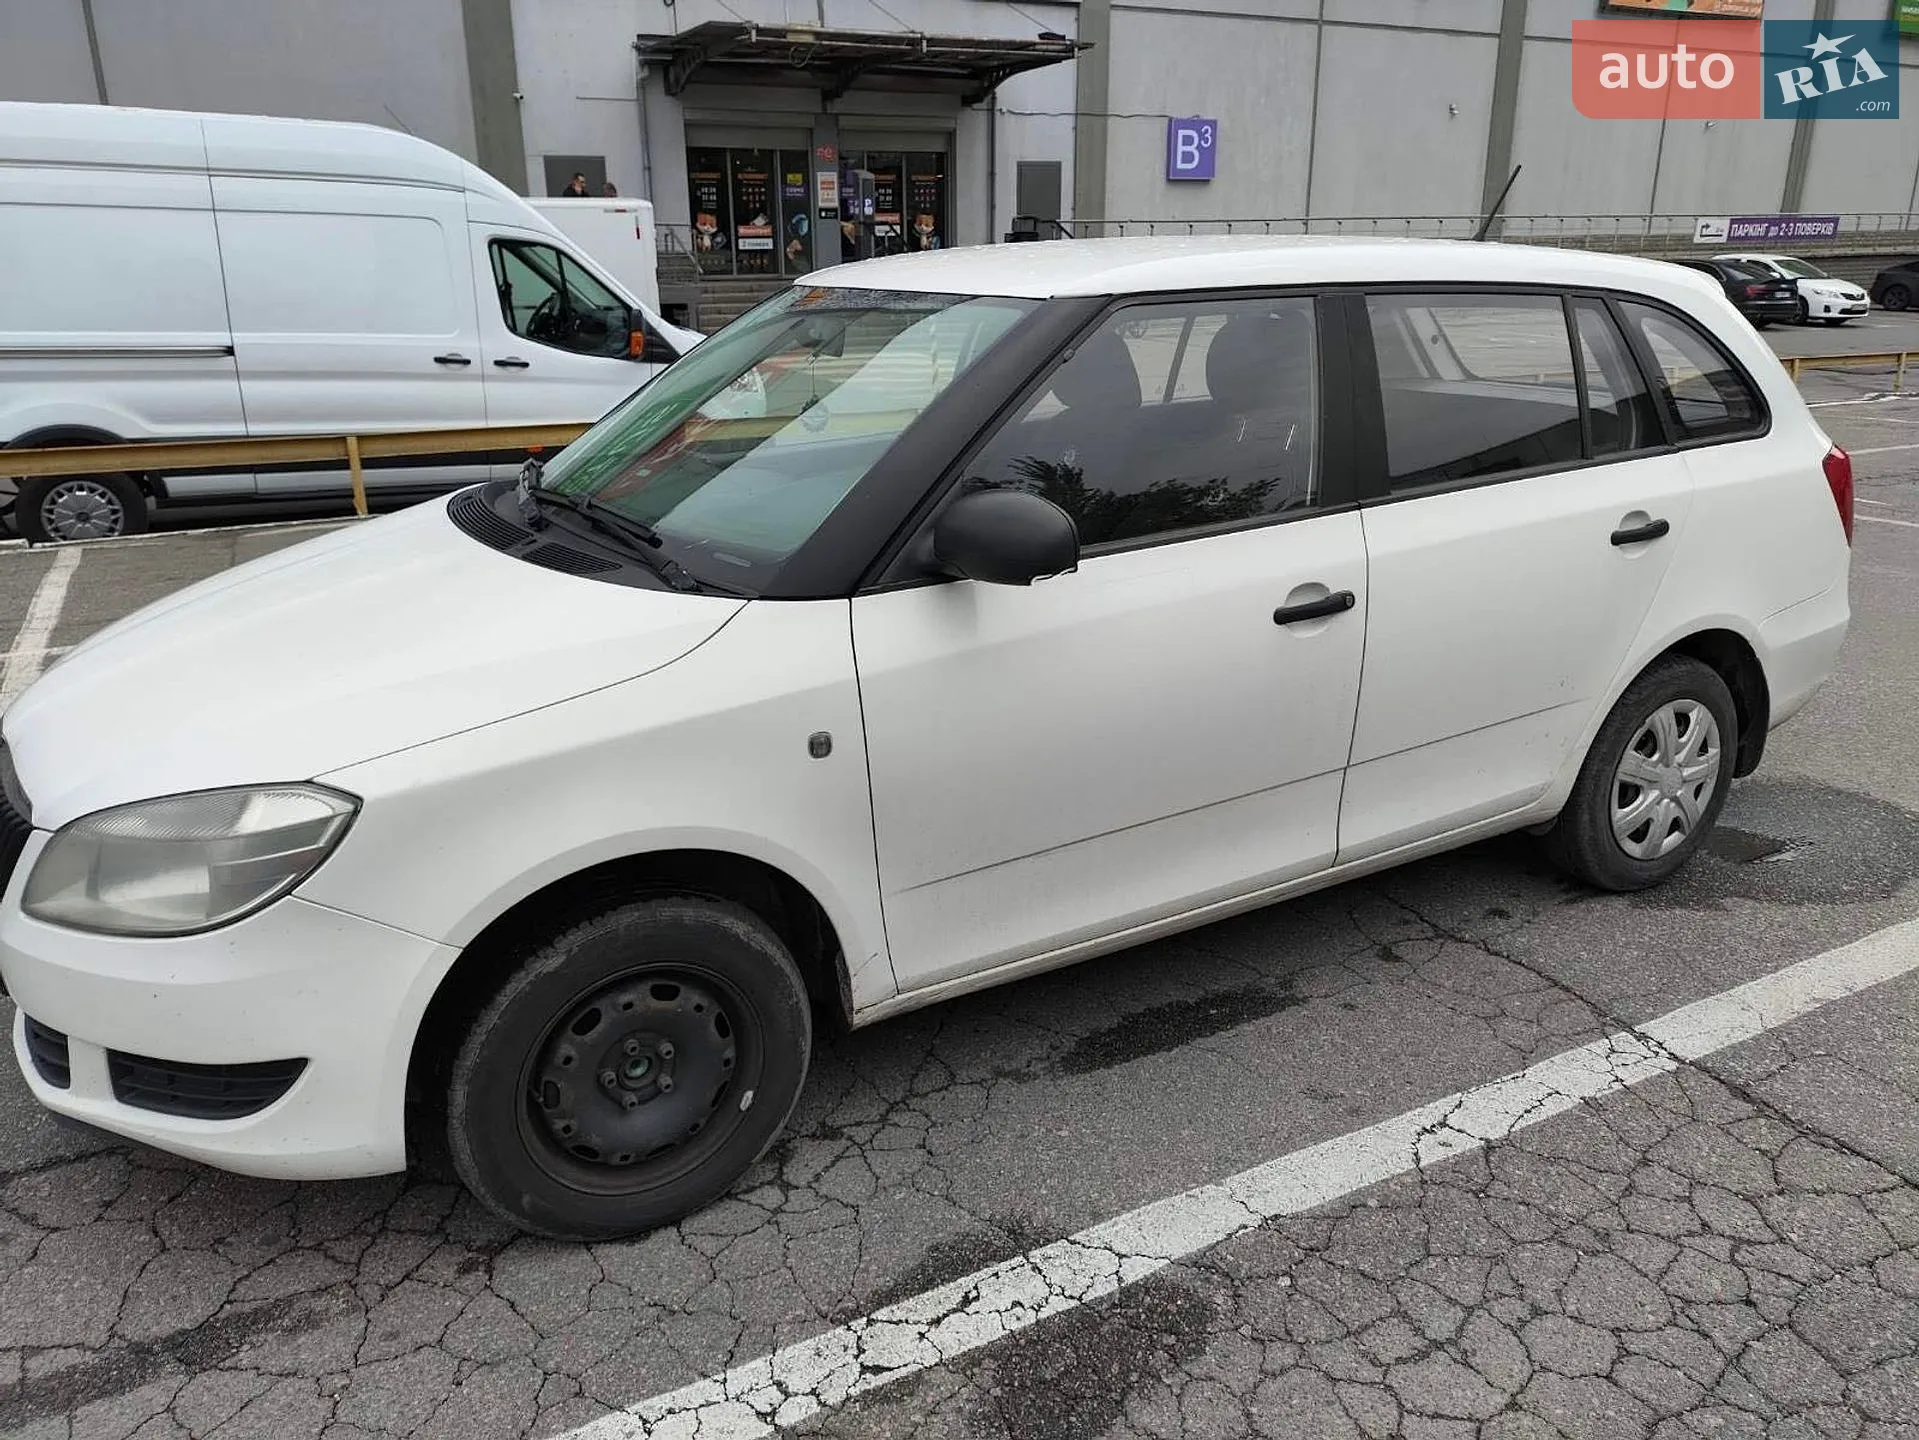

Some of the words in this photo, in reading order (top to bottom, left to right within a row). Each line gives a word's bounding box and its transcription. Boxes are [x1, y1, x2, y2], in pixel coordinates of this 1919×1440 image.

[1730, 223, 1768, 237] ПАРКІНГ
[1780, 223, 1794, 236] 2-3
[1795, 222, 1834, 235] ПОВЕРХІВ
